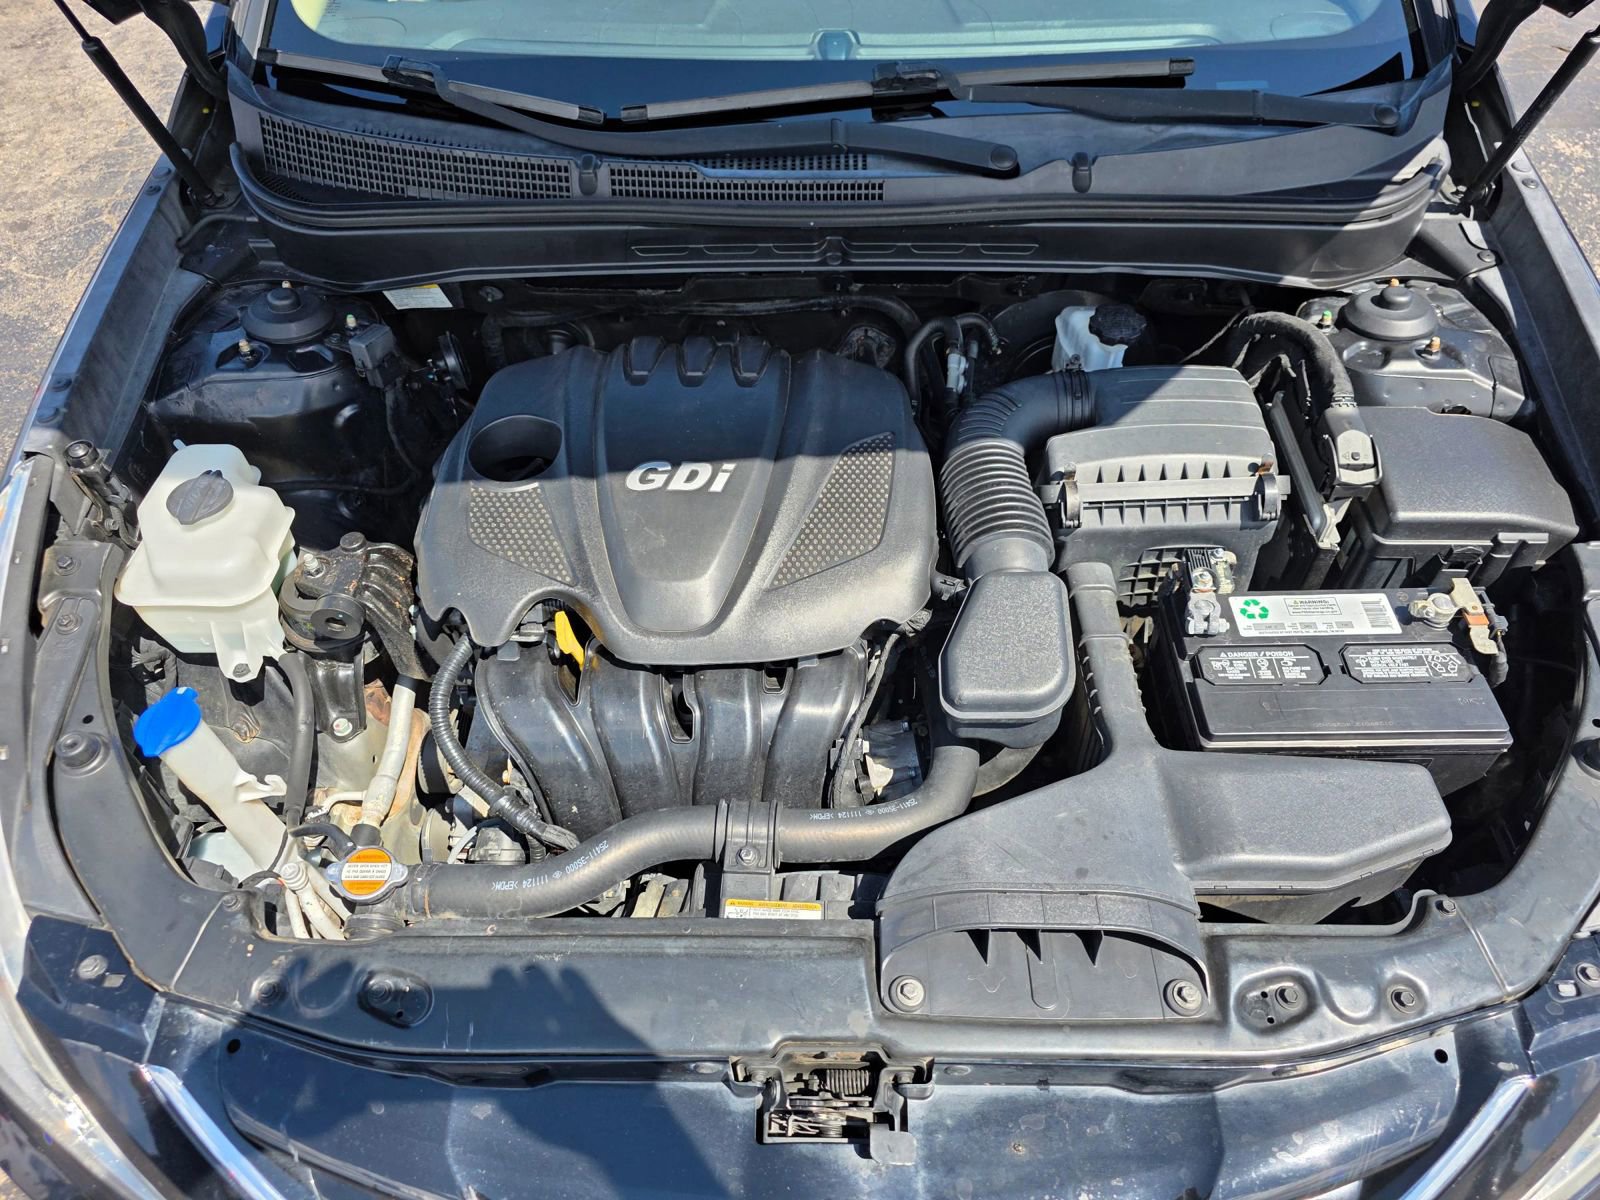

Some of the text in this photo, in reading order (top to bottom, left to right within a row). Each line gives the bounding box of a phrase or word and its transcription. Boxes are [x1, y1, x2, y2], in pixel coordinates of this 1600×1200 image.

[626, 461, 737, 492] GDi
[837, 811, 862, 819] 111124
[522, 874, 549, 889] 111124
